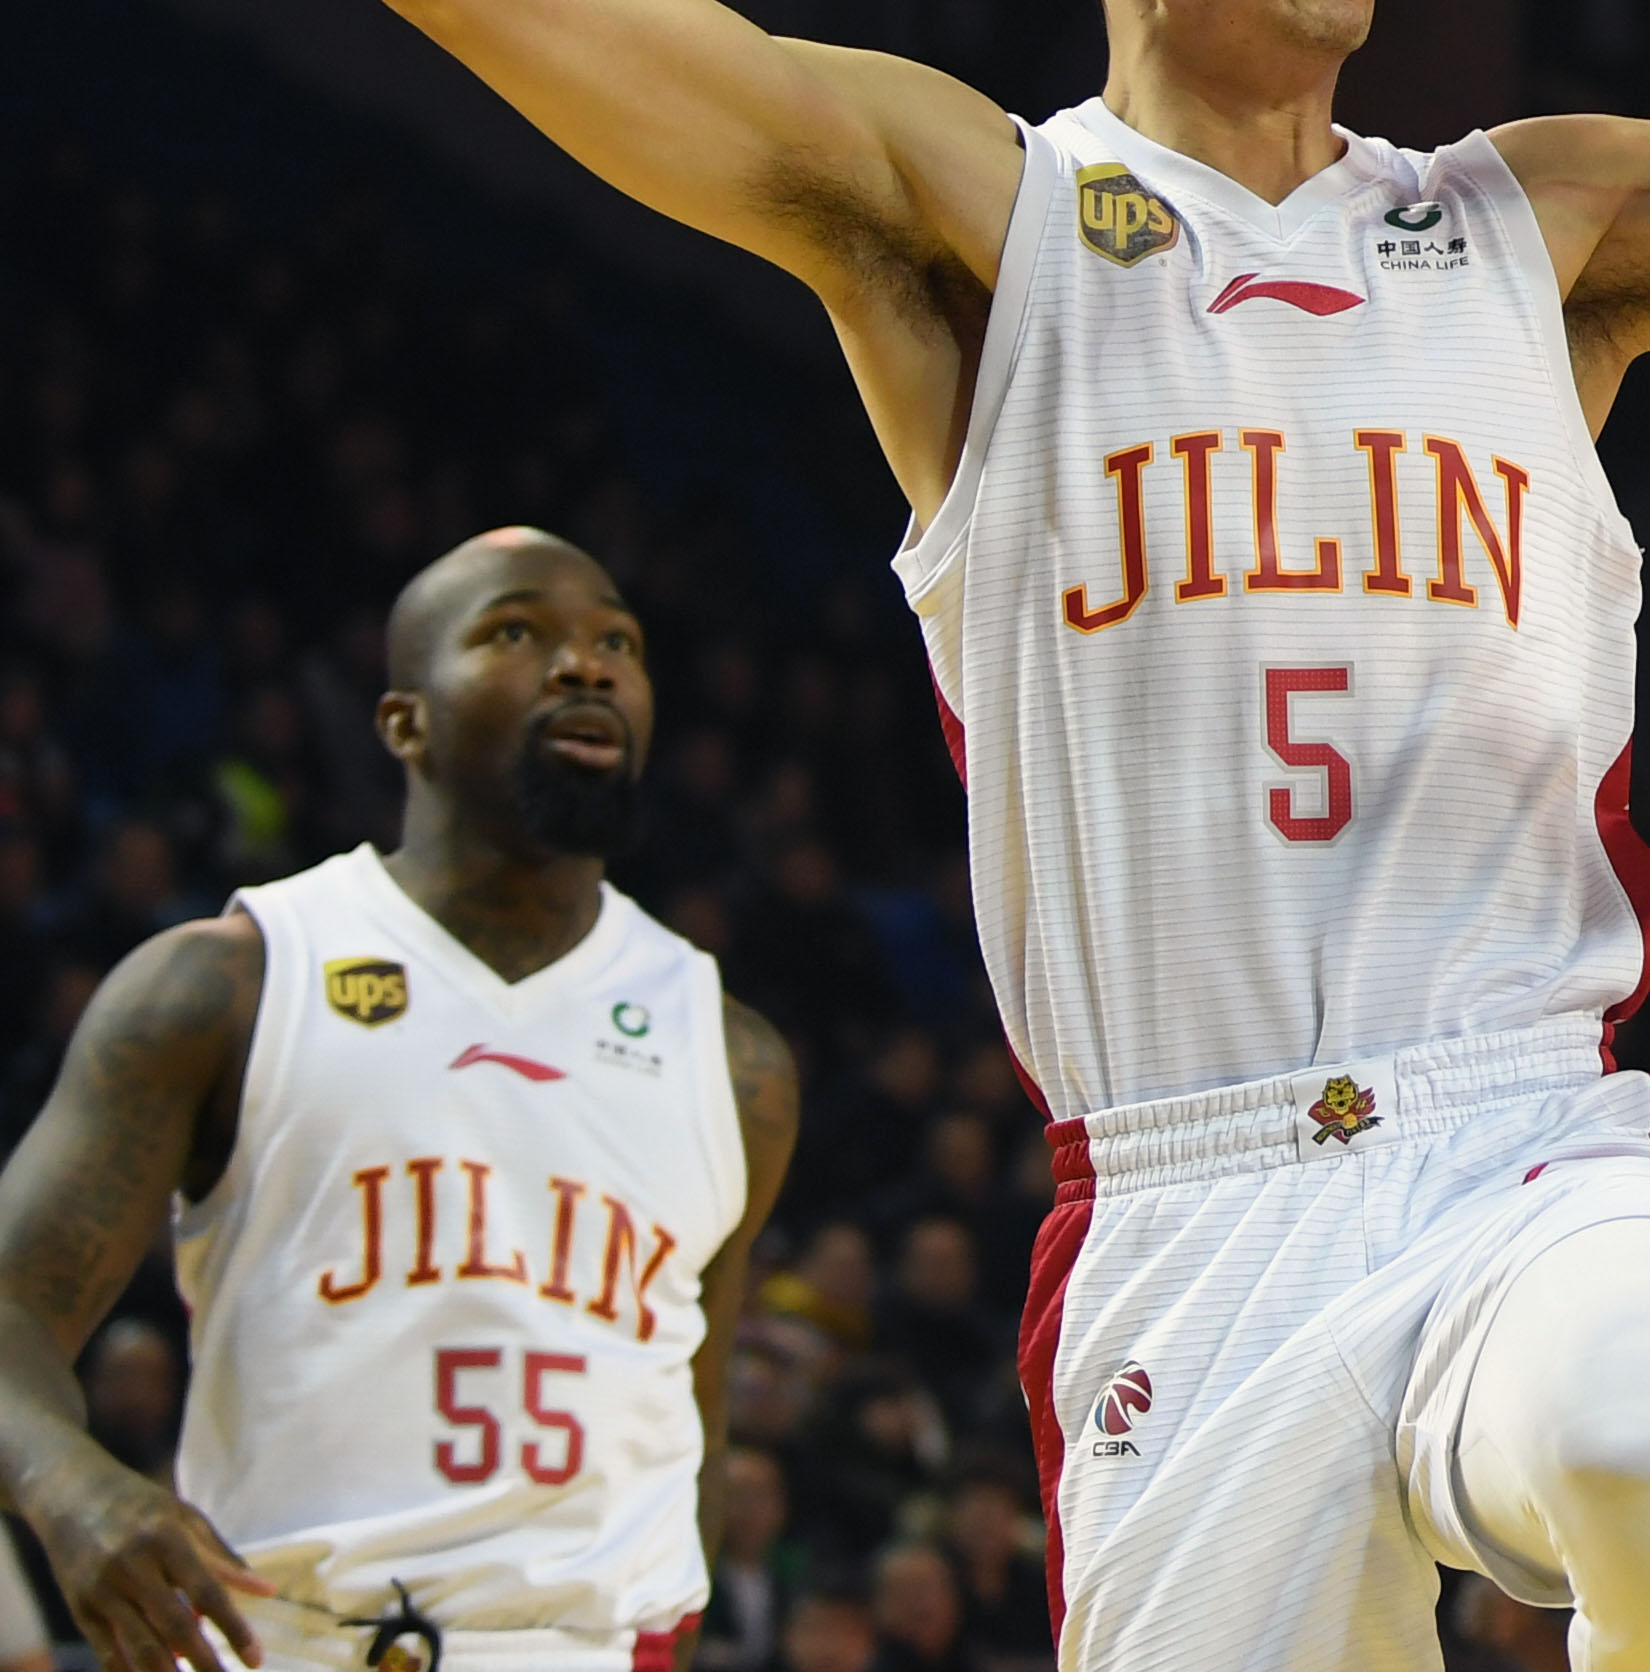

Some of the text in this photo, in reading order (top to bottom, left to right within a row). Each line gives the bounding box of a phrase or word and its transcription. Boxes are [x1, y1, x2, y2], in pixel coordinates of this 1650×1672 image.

[1083, 188, 1172, 249] ups
[1376, 237, 1467, 258] 中国人寿
[1380, 256, 1469, 270] CHINA LIFE
[1062, 428, 1530, 634] JILIN
[1260, 661, 1357, 848] 5
[330, 973, 405, 1017] ups
[318, 1157, 677, 1342] JILIN
[433, 1346, 586, 1486] 55
[1093, 1440, 1141, 1457] CBA
